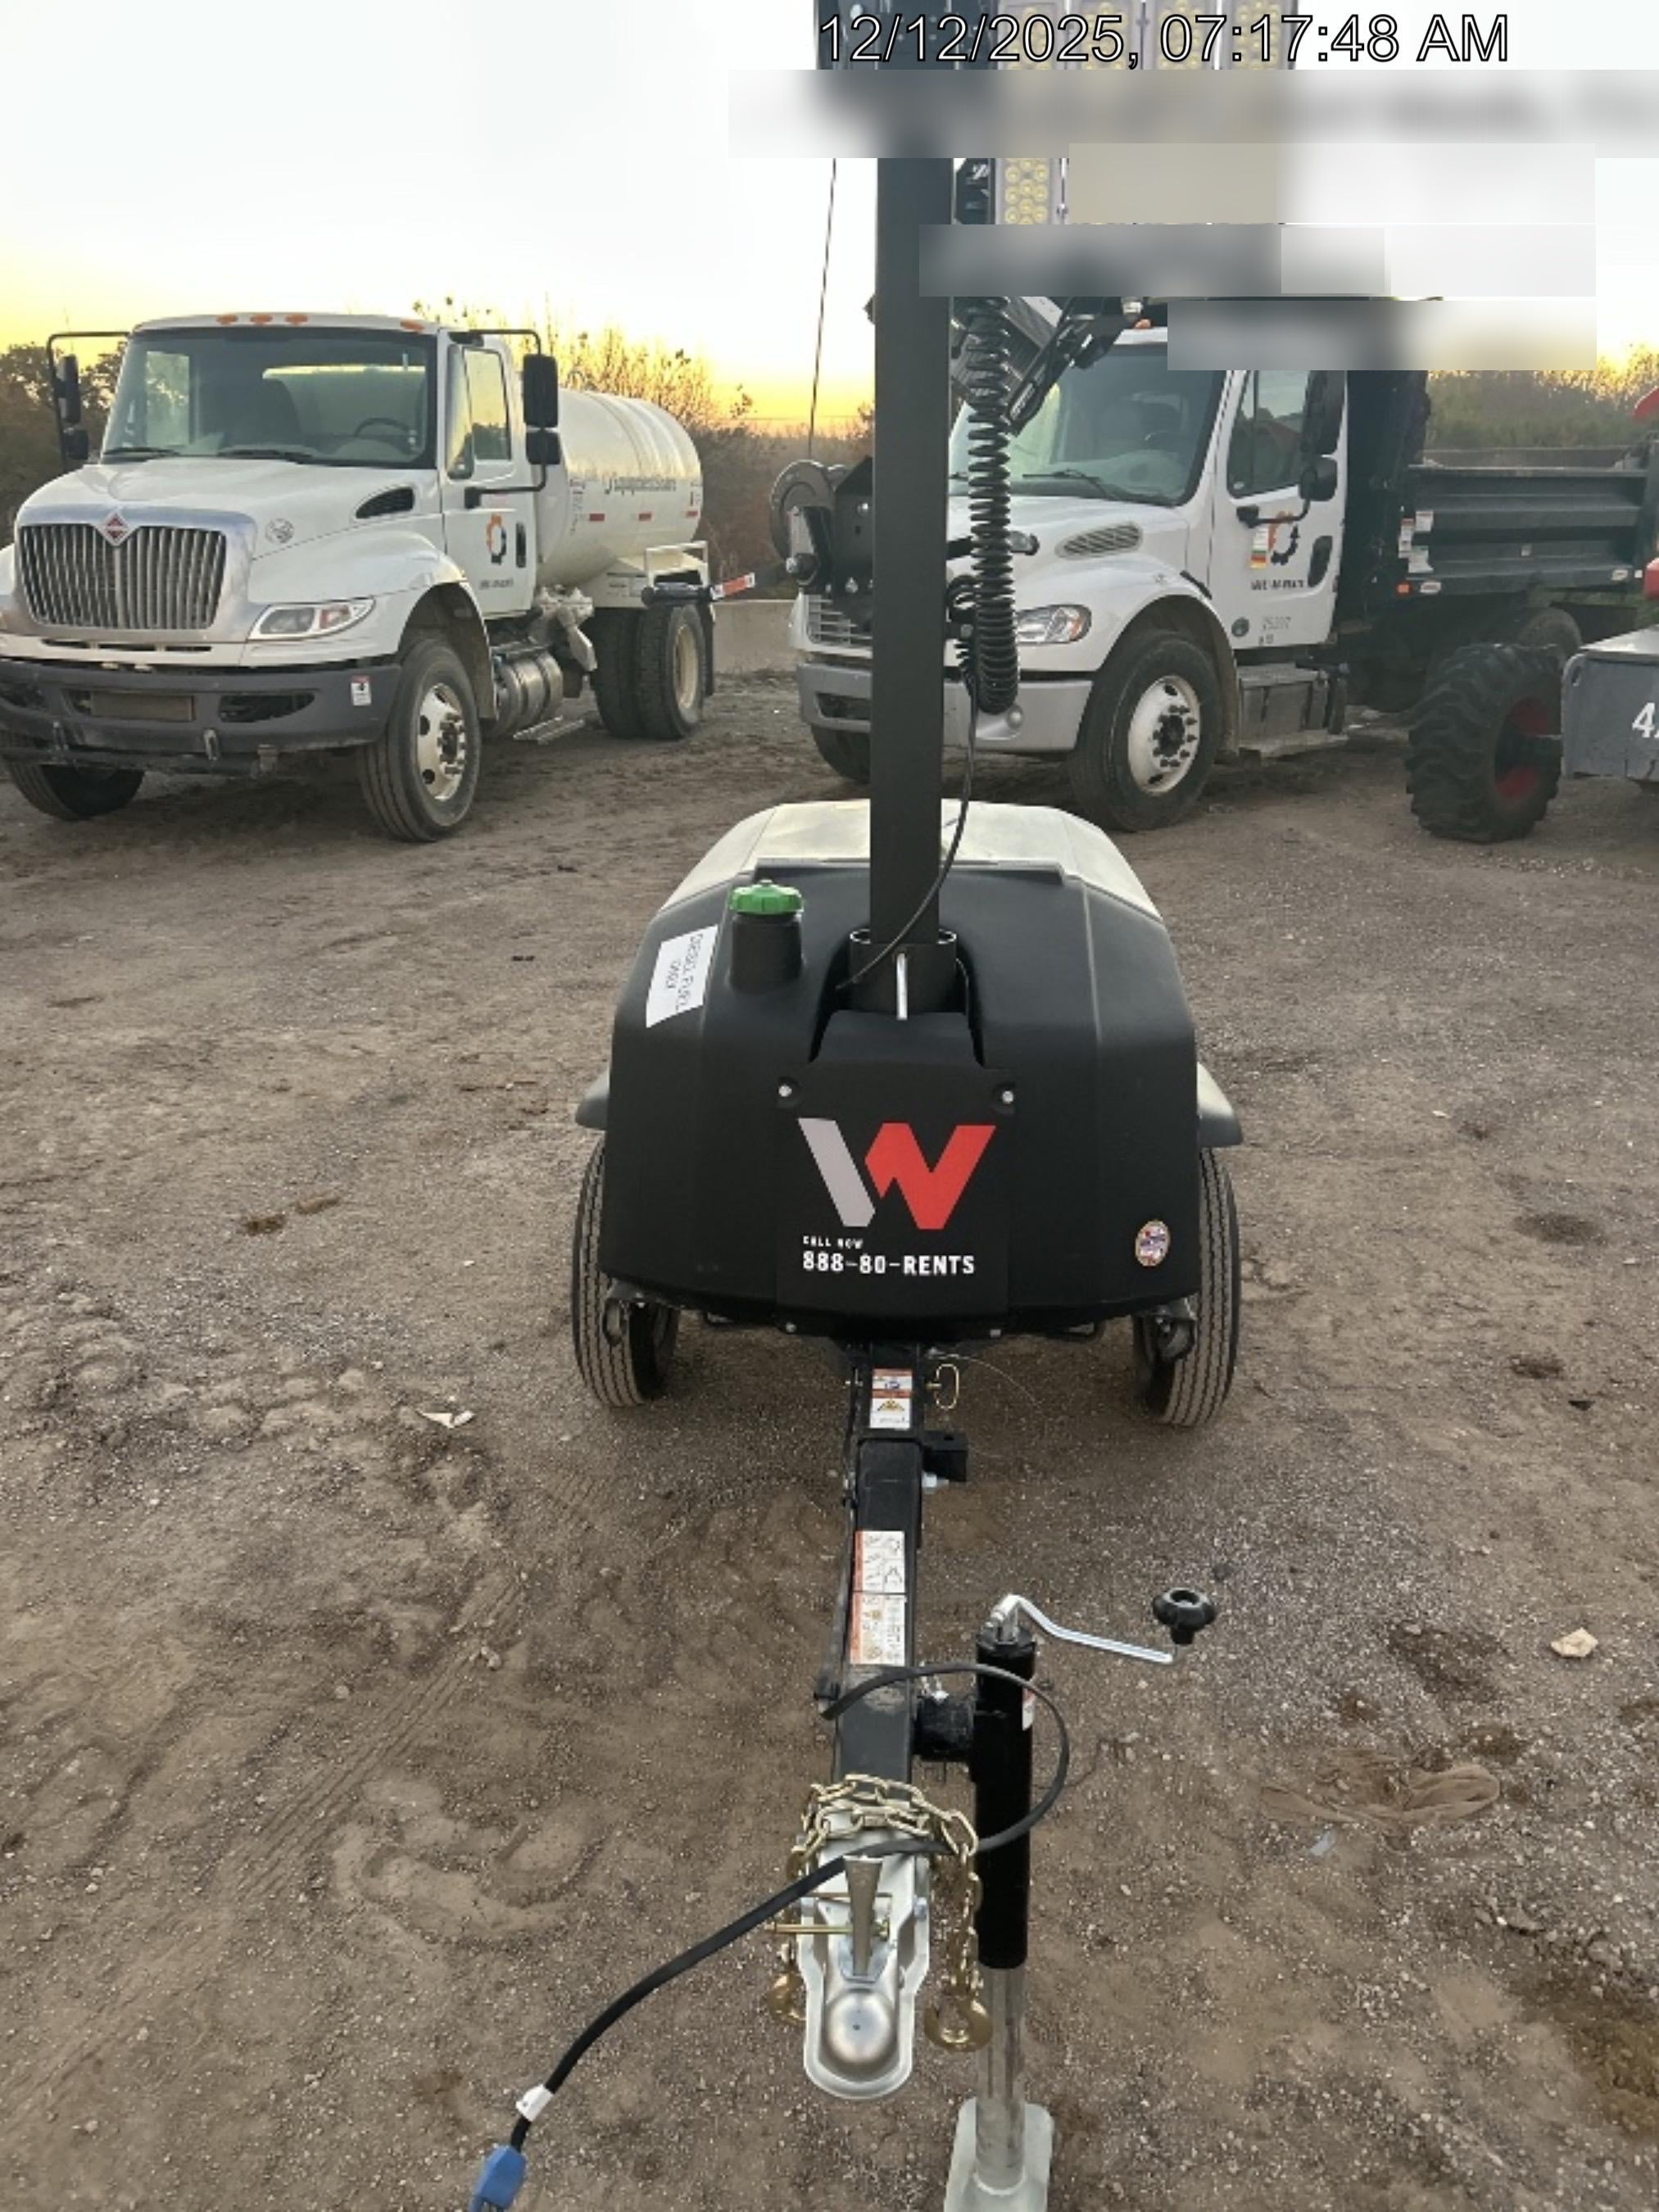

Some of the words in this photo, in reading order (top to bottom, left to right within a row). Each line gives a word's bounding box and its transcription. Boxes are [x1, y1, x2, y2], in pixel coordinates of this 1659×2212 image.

[803, 1235, 832, 1247] CALL
[837, 1238, 863, 1249] NOW
[802, 1250, 976, 1276] 888-80-RENTS
